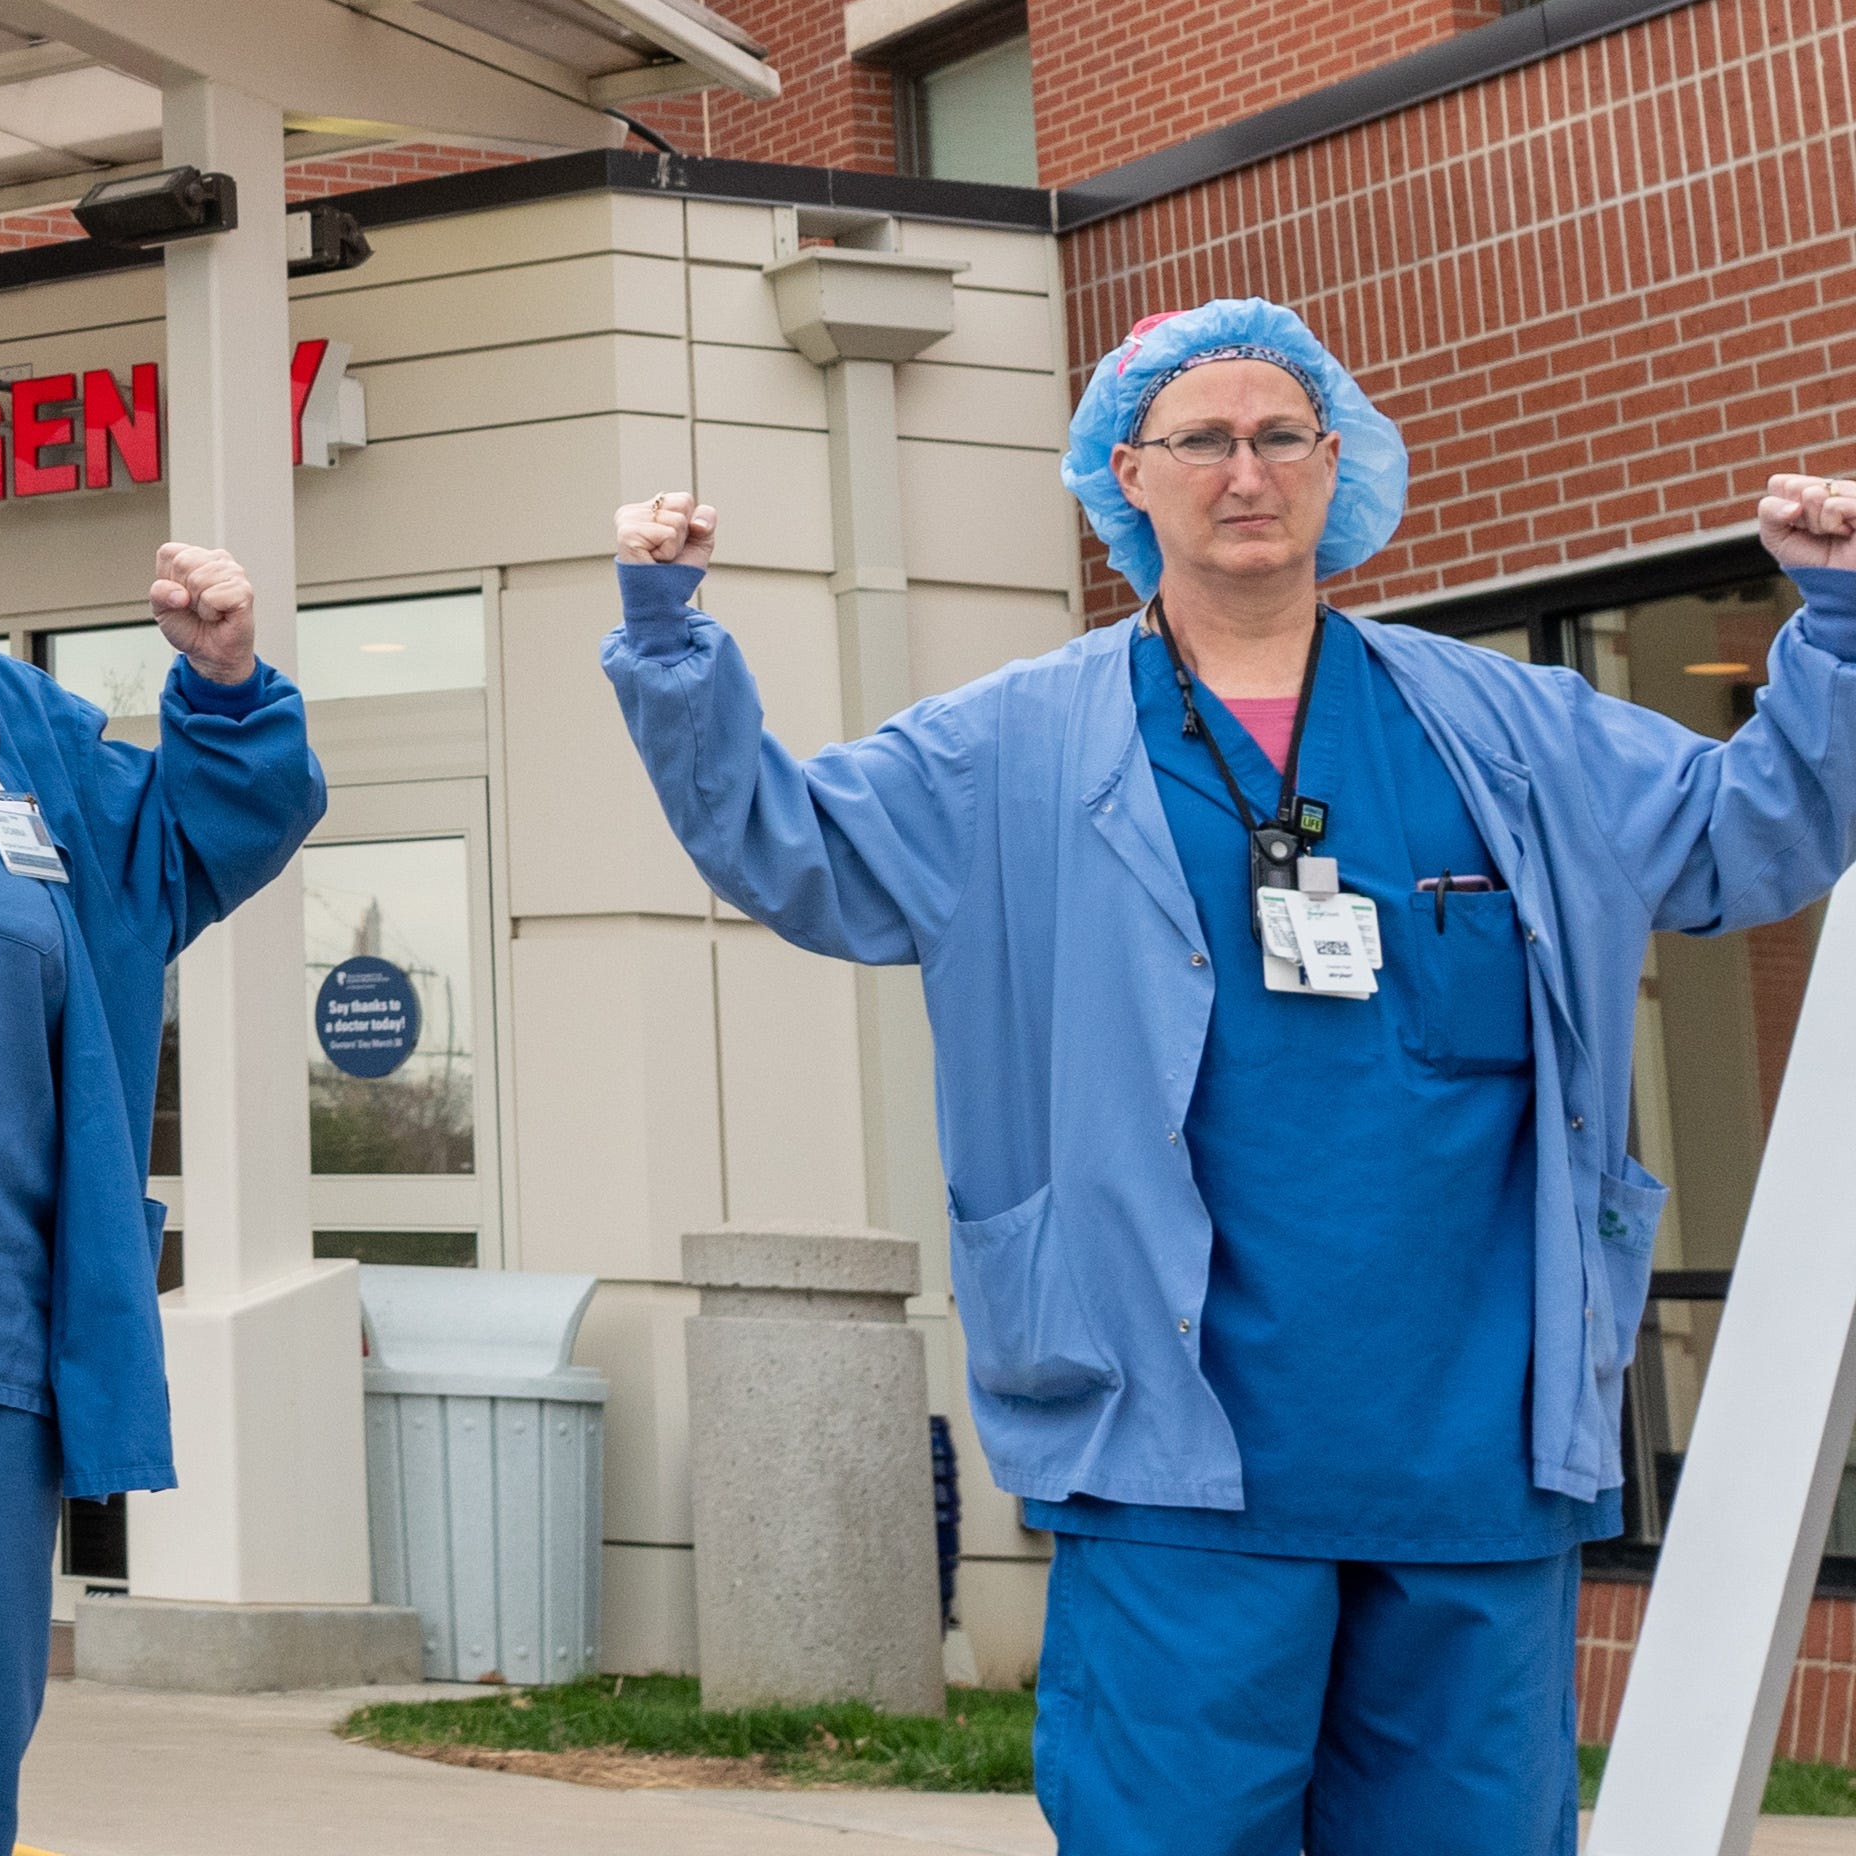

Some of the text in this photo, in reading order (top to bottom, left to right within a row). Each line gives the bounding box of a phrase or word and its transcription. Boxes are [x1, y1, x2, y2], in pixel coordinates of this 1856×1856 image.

[1302, 816, 1321, 831] LIFE
[328, 998, 401, 1016] Say thanks to
[324, 1016, 406, 1033] a doctor today!
